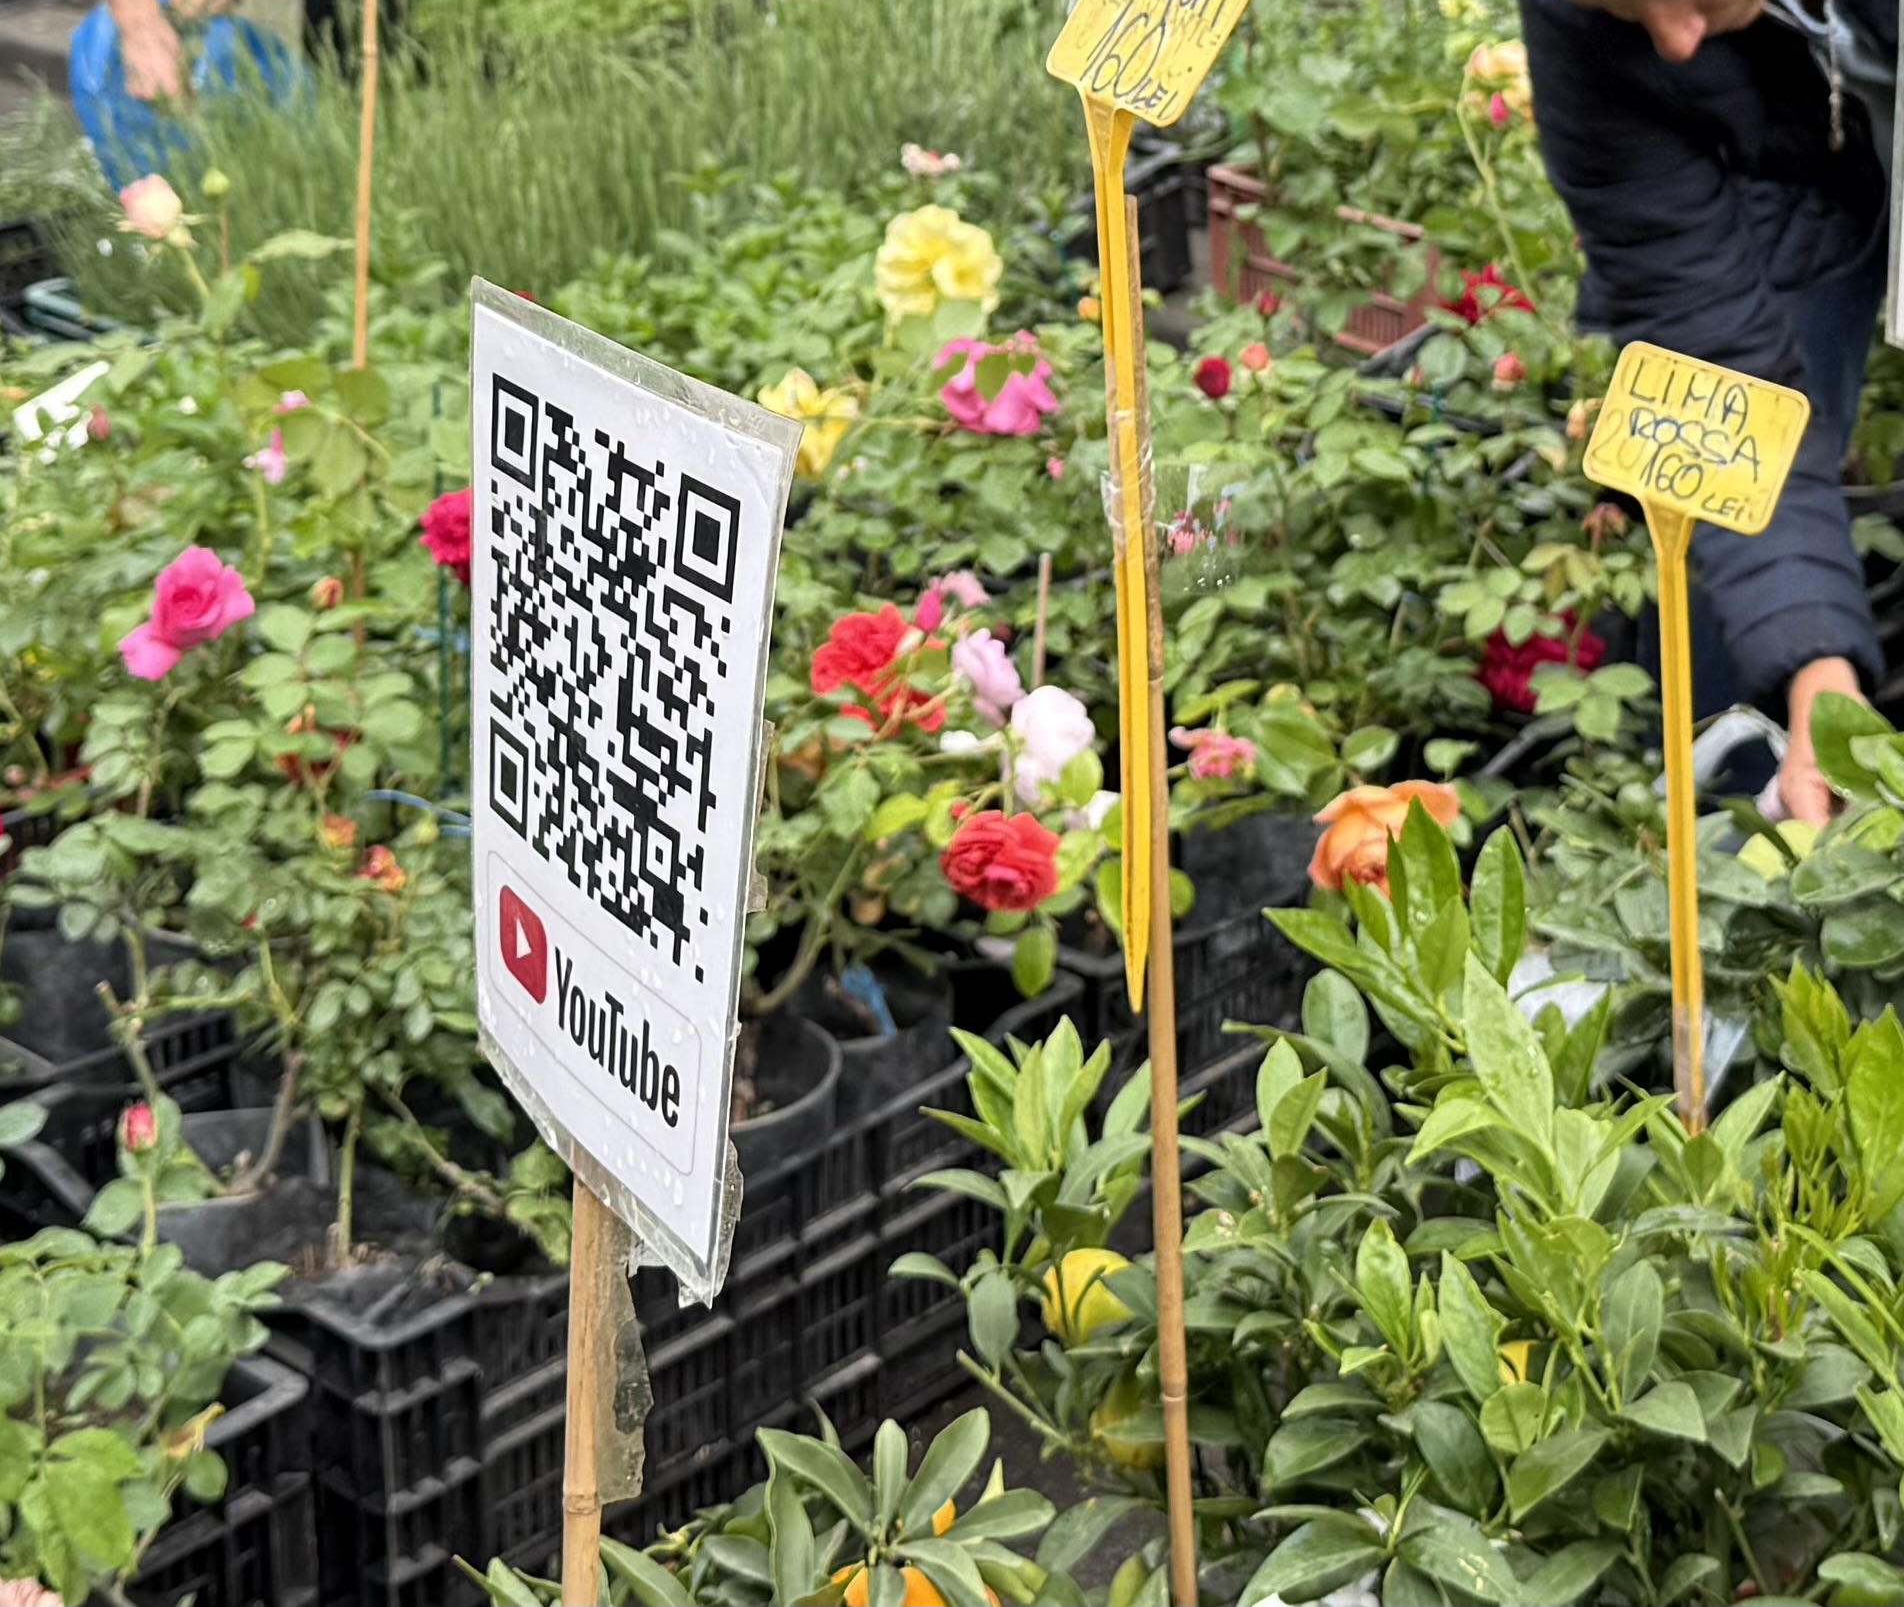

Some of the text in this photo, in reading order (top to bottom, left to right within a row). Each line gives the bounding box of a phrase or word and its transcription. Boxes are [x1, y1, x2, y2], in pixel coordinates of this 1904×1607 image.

[1079, 0, 1168, 99] 160
[1628, 356, 1749, 436] LIMA
[1629, 406, 1761, 484] ROSSA
[1639, 444, 1704, 501] 160
[553, 944, 682, 1130] YouTube
